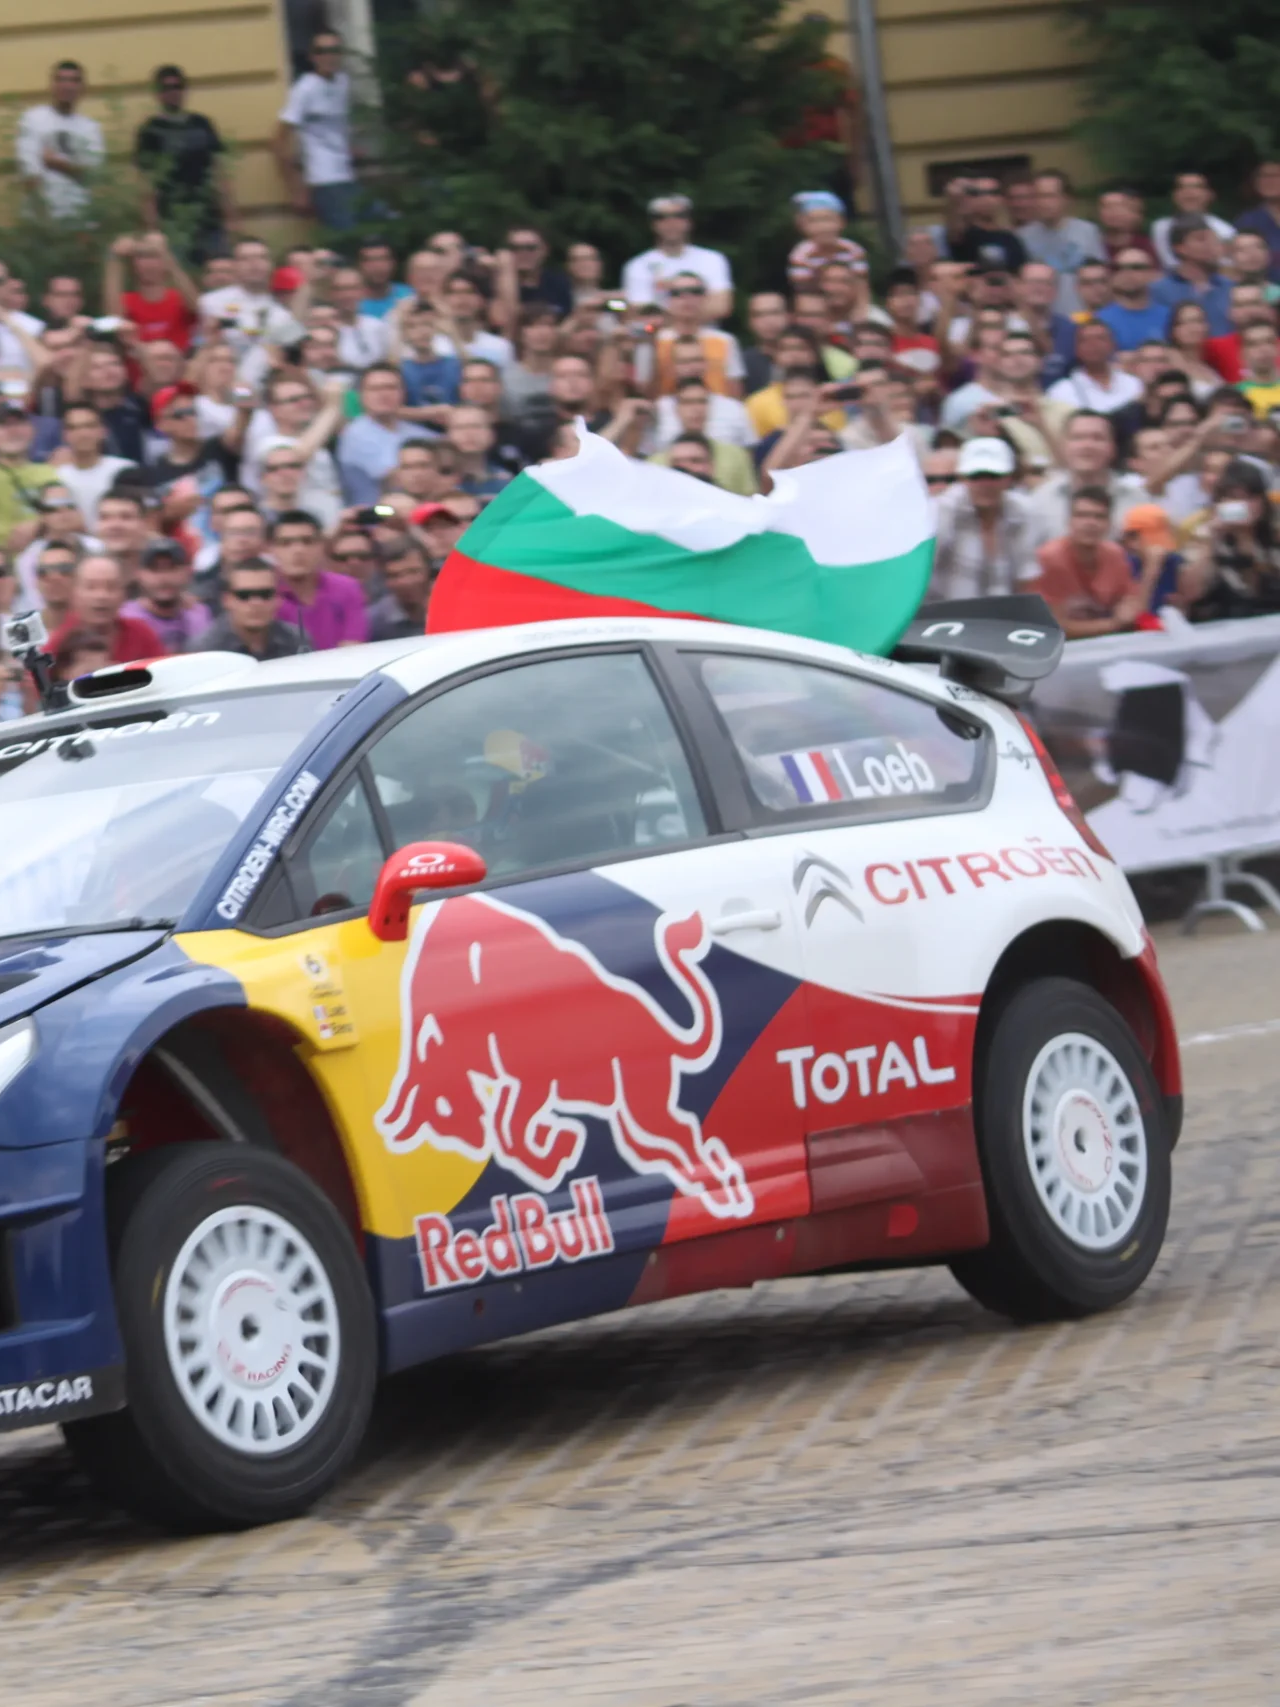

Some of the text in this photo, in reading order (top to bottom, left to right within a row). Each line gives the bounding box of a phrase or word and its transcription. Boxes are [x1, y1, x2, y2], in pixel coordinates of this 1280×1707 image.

[832, 741, 935, 799] Loeb
[864, 836, 1101, 906] CITROËN
[776, 1036, 955, 1108] TOTAL
[415, 1174, 613, 1291] Red Bull
